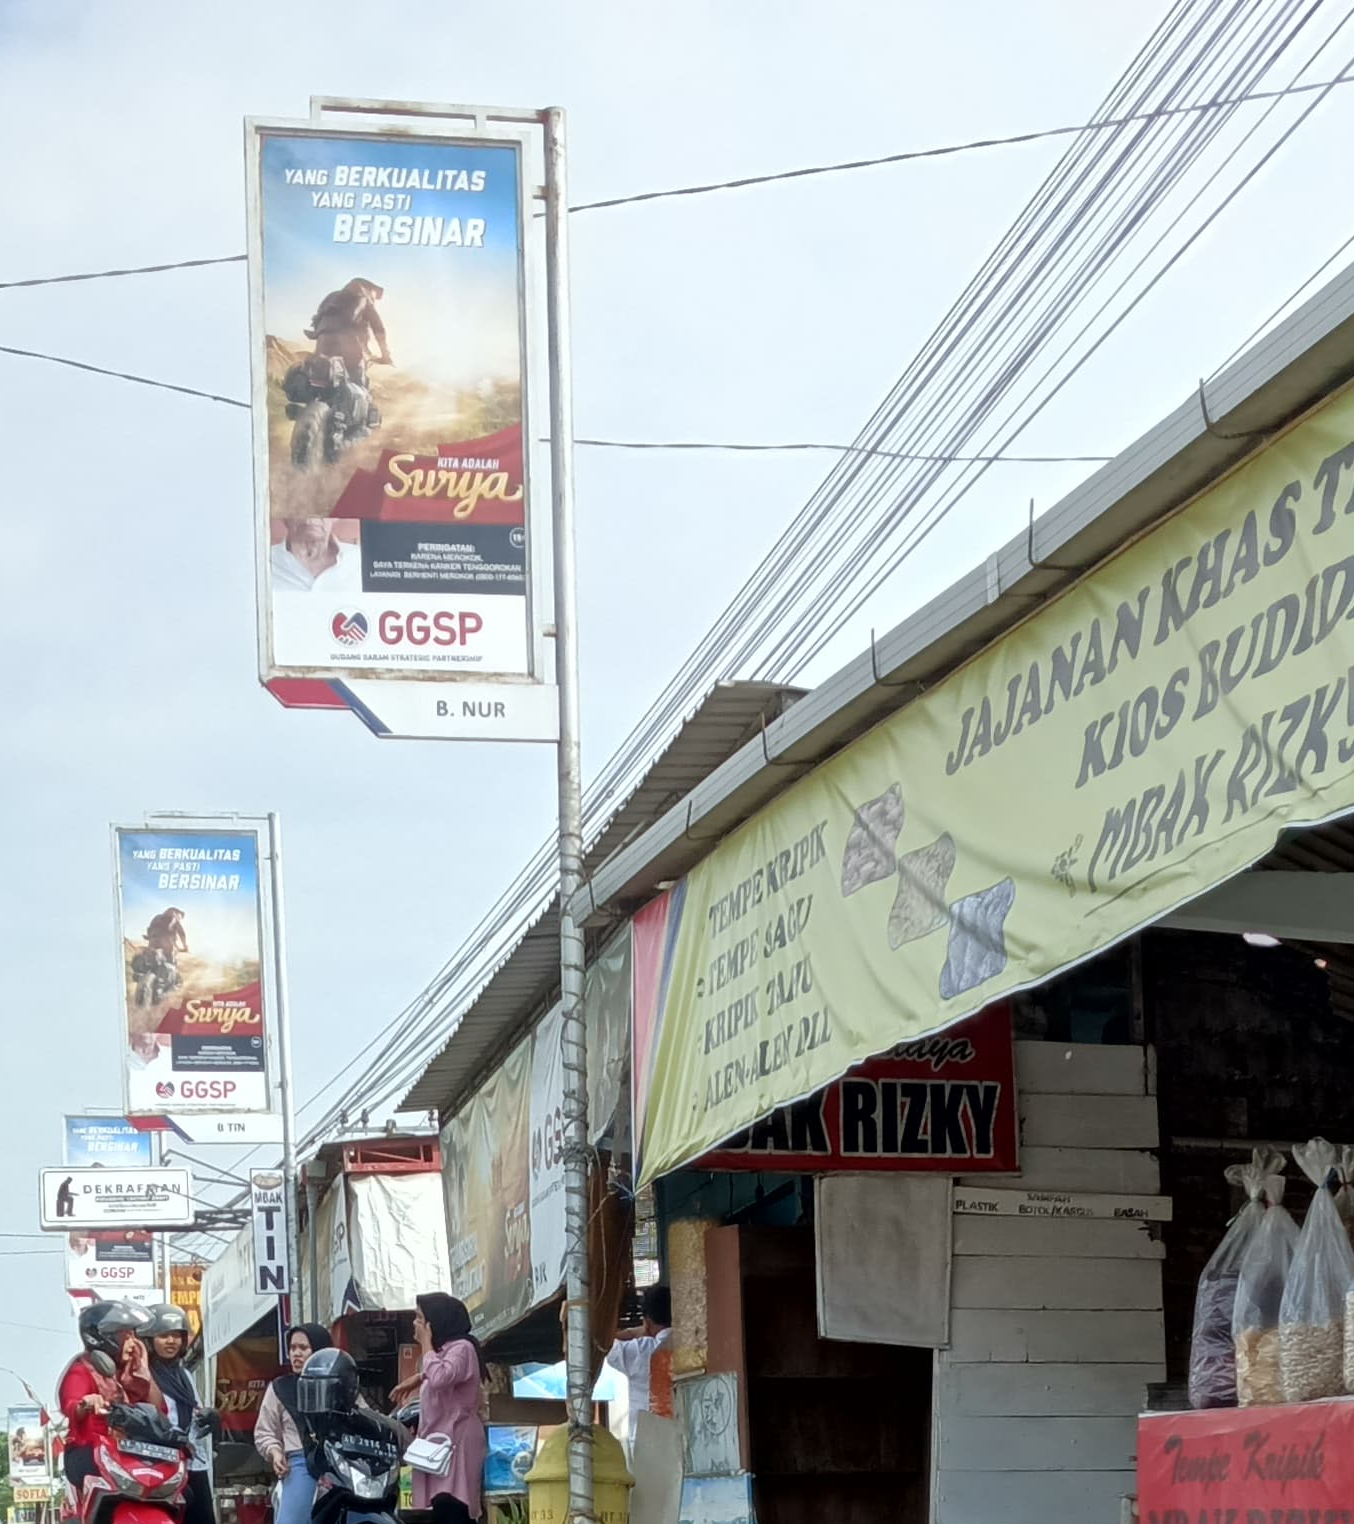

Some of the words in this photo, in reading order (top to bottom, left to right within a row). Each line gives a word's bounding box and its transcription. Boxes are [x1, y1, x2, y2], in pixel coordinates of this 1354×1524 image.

[285, 168, 328, 186] YANG
[334, 165, 487, 192] BERKUALITAS
[311, 191, 357, 209] YANG
[361, 192, 412, 211] PASTI
[332, 213, 487, 248] BERSINAR
[383, 453, 524, 519] Surya
[378, 610, 483, 646] GGSP
[944, 586, 1150, 775] JAJANAN
[1154, 479, 1301, 645] KHAS
[436, 700, 455, 718] B.
[462, 701, 506, 718] NUR
[1075, 669, 1189, 789] KIOS
[1088, 748, 1226, 893] MBAK
[159, 848, 241, 861] BERKUALITAS
[158, 873, 240, 890] BERSINAR
[709, 868, 763, 939] TEMPE
[766, 819, 828, 896] KRIPIK
[709, 928, 760, 996] TEMPE
[763, 894, 814, 959] SAGU
[184, 999, 261, 1034] Surya
[704, 986, 760, 1055] KRIPIK
[766, 952, 813, 1017] TAHU
[795, 1005, 832, 1059] DLL
[180, 1080, 236, 1099] GGSP
[228, 1123, 246, 1132] TIN
[839, 1078, 1001, 1158] RIZKY
[254, 1191, 283, 1204] MBAK
[955, 1200, 999, 1212] PLASTIK
[101, 1267, 135, 1278] GGSP
[1163, 1434, 1231, 1494] Tempe
[1243, 1428, 1326, 1496] Kripik
[16, 1489, 46, 1500] SOFIA
